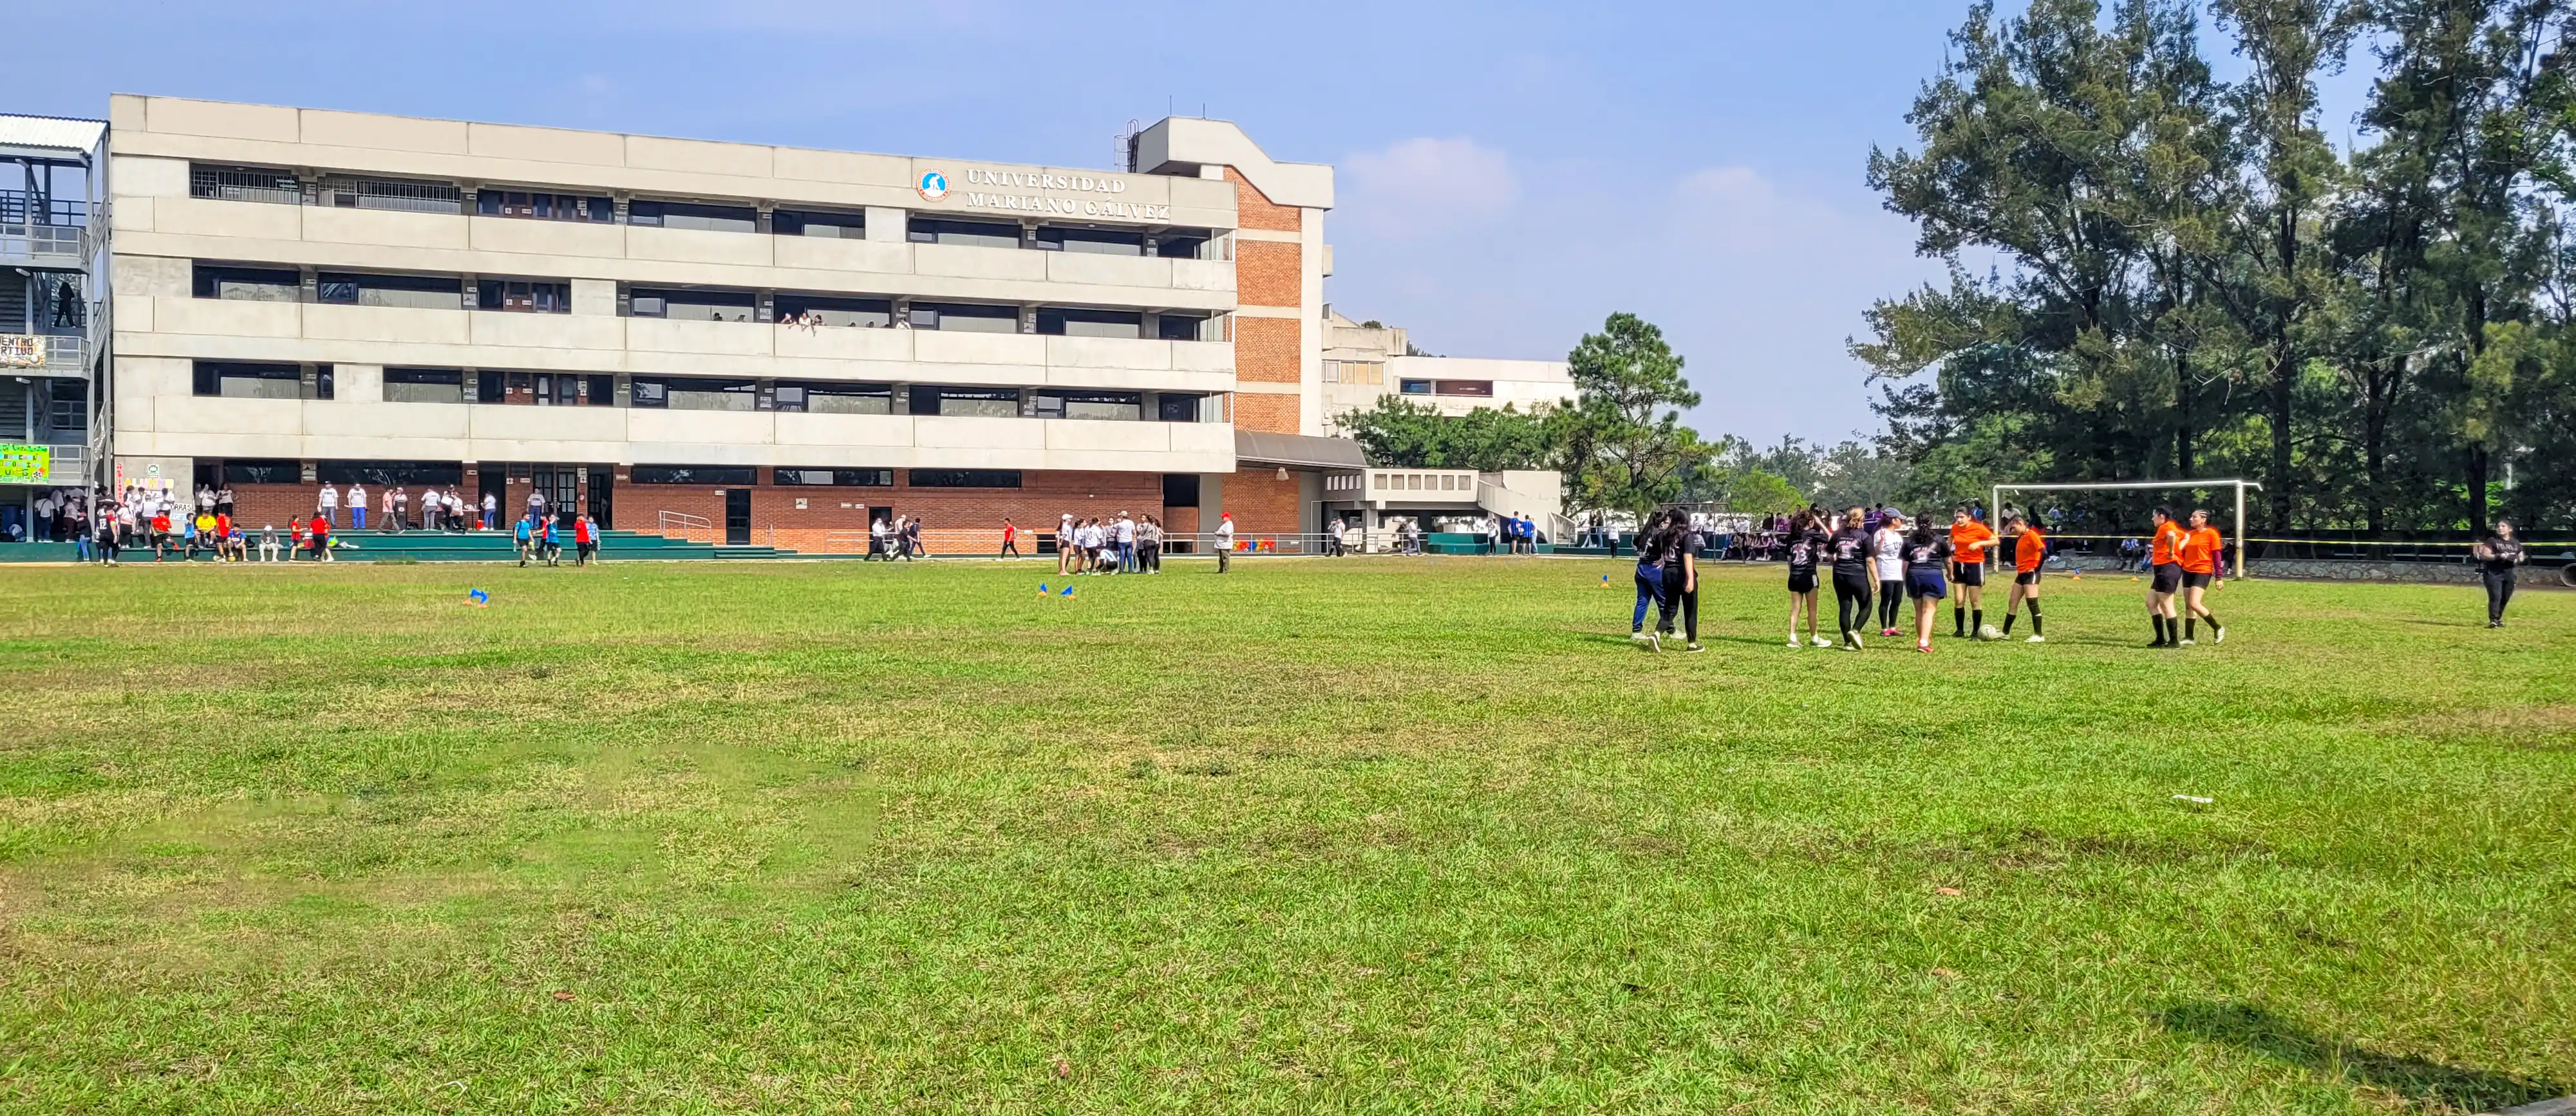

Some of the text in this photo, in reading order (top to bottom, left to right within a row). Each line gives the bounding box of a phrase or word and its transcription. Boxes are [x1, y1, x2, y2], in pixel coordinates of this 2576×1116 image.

[966, 169, 1125, 193] UNIVERSIDAD
[966, 192, 1170, 219] MARIANO GÁLVEZ
[0, 337, 33, 346] ENTRO
[99, 521, 107, 530] 12
[1792, 549, 1807, 565] 23
